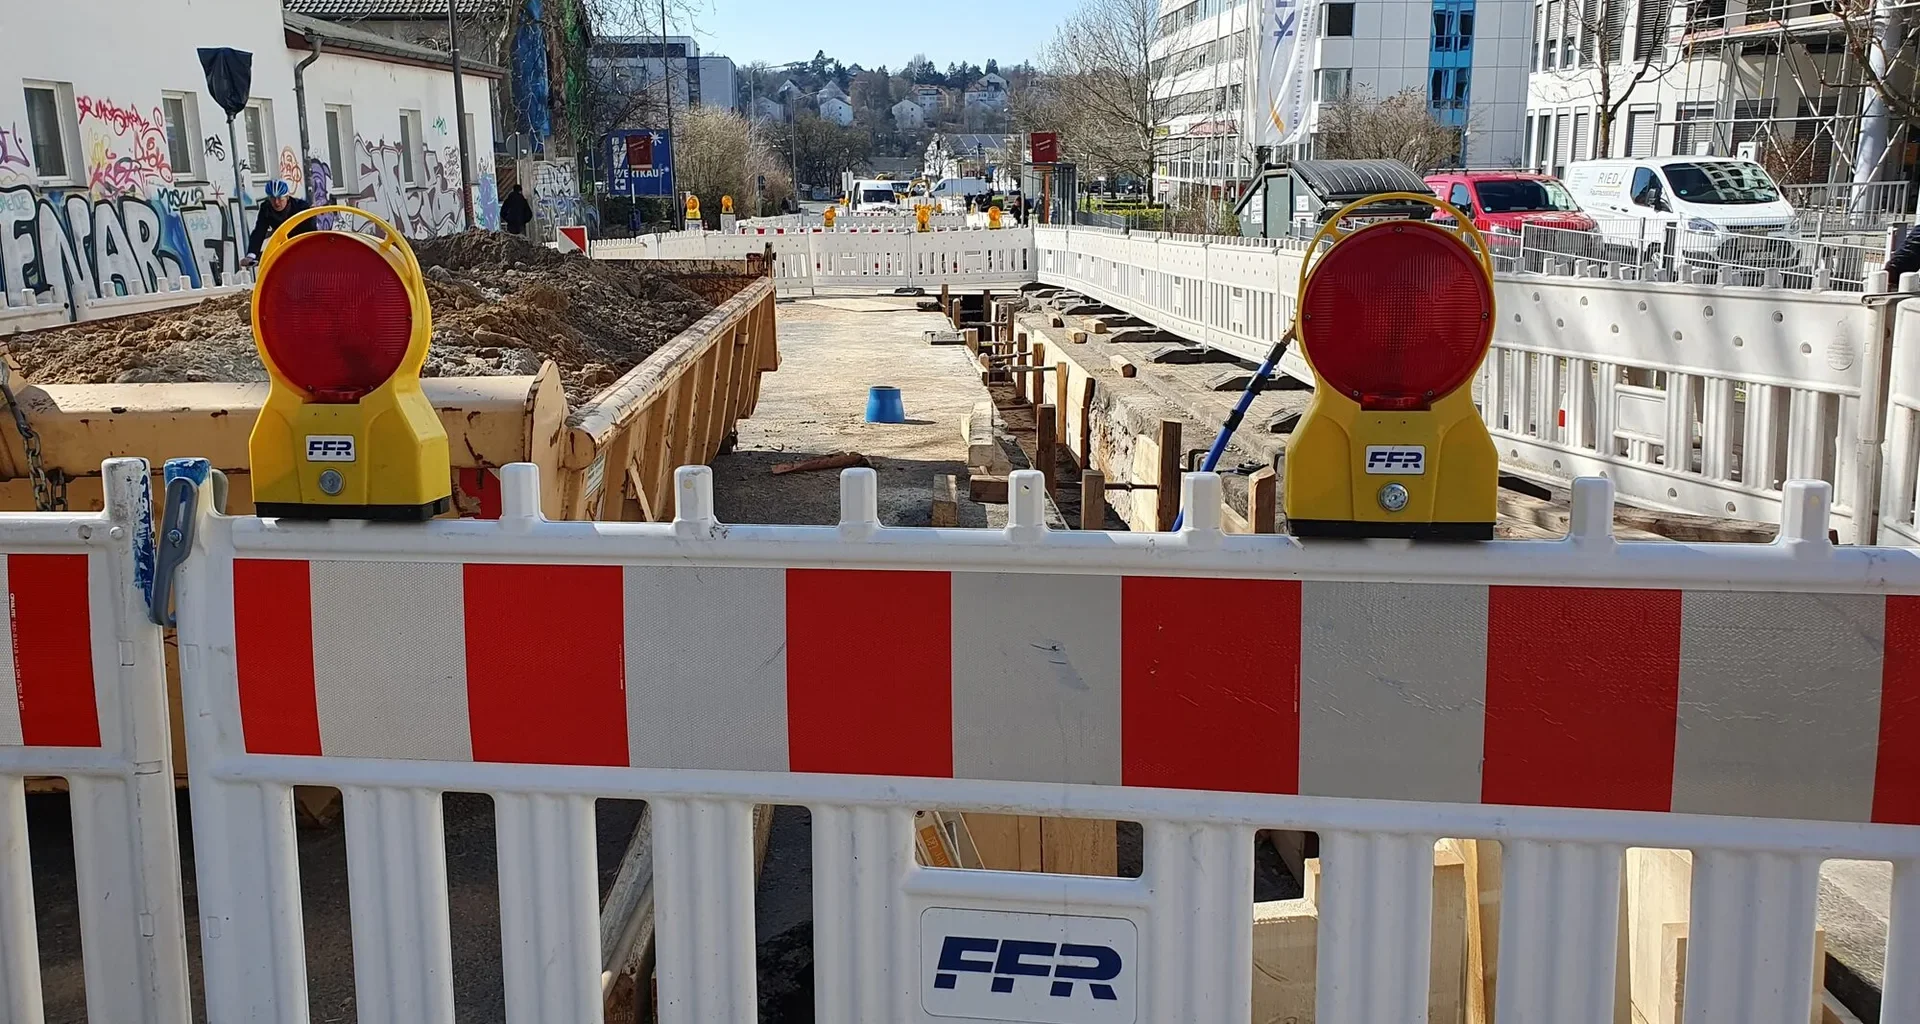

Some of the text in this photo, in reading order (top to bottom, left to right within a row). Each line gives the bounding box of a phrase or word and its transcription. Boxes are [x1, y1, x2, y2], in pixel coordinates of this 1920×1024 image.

[1273, 0, 1295, 37] K
[308, 440, 352, 456] FFR
[1368, 451, 1422, 469] FFR
[933, 935, 1122, 1001] FFR
